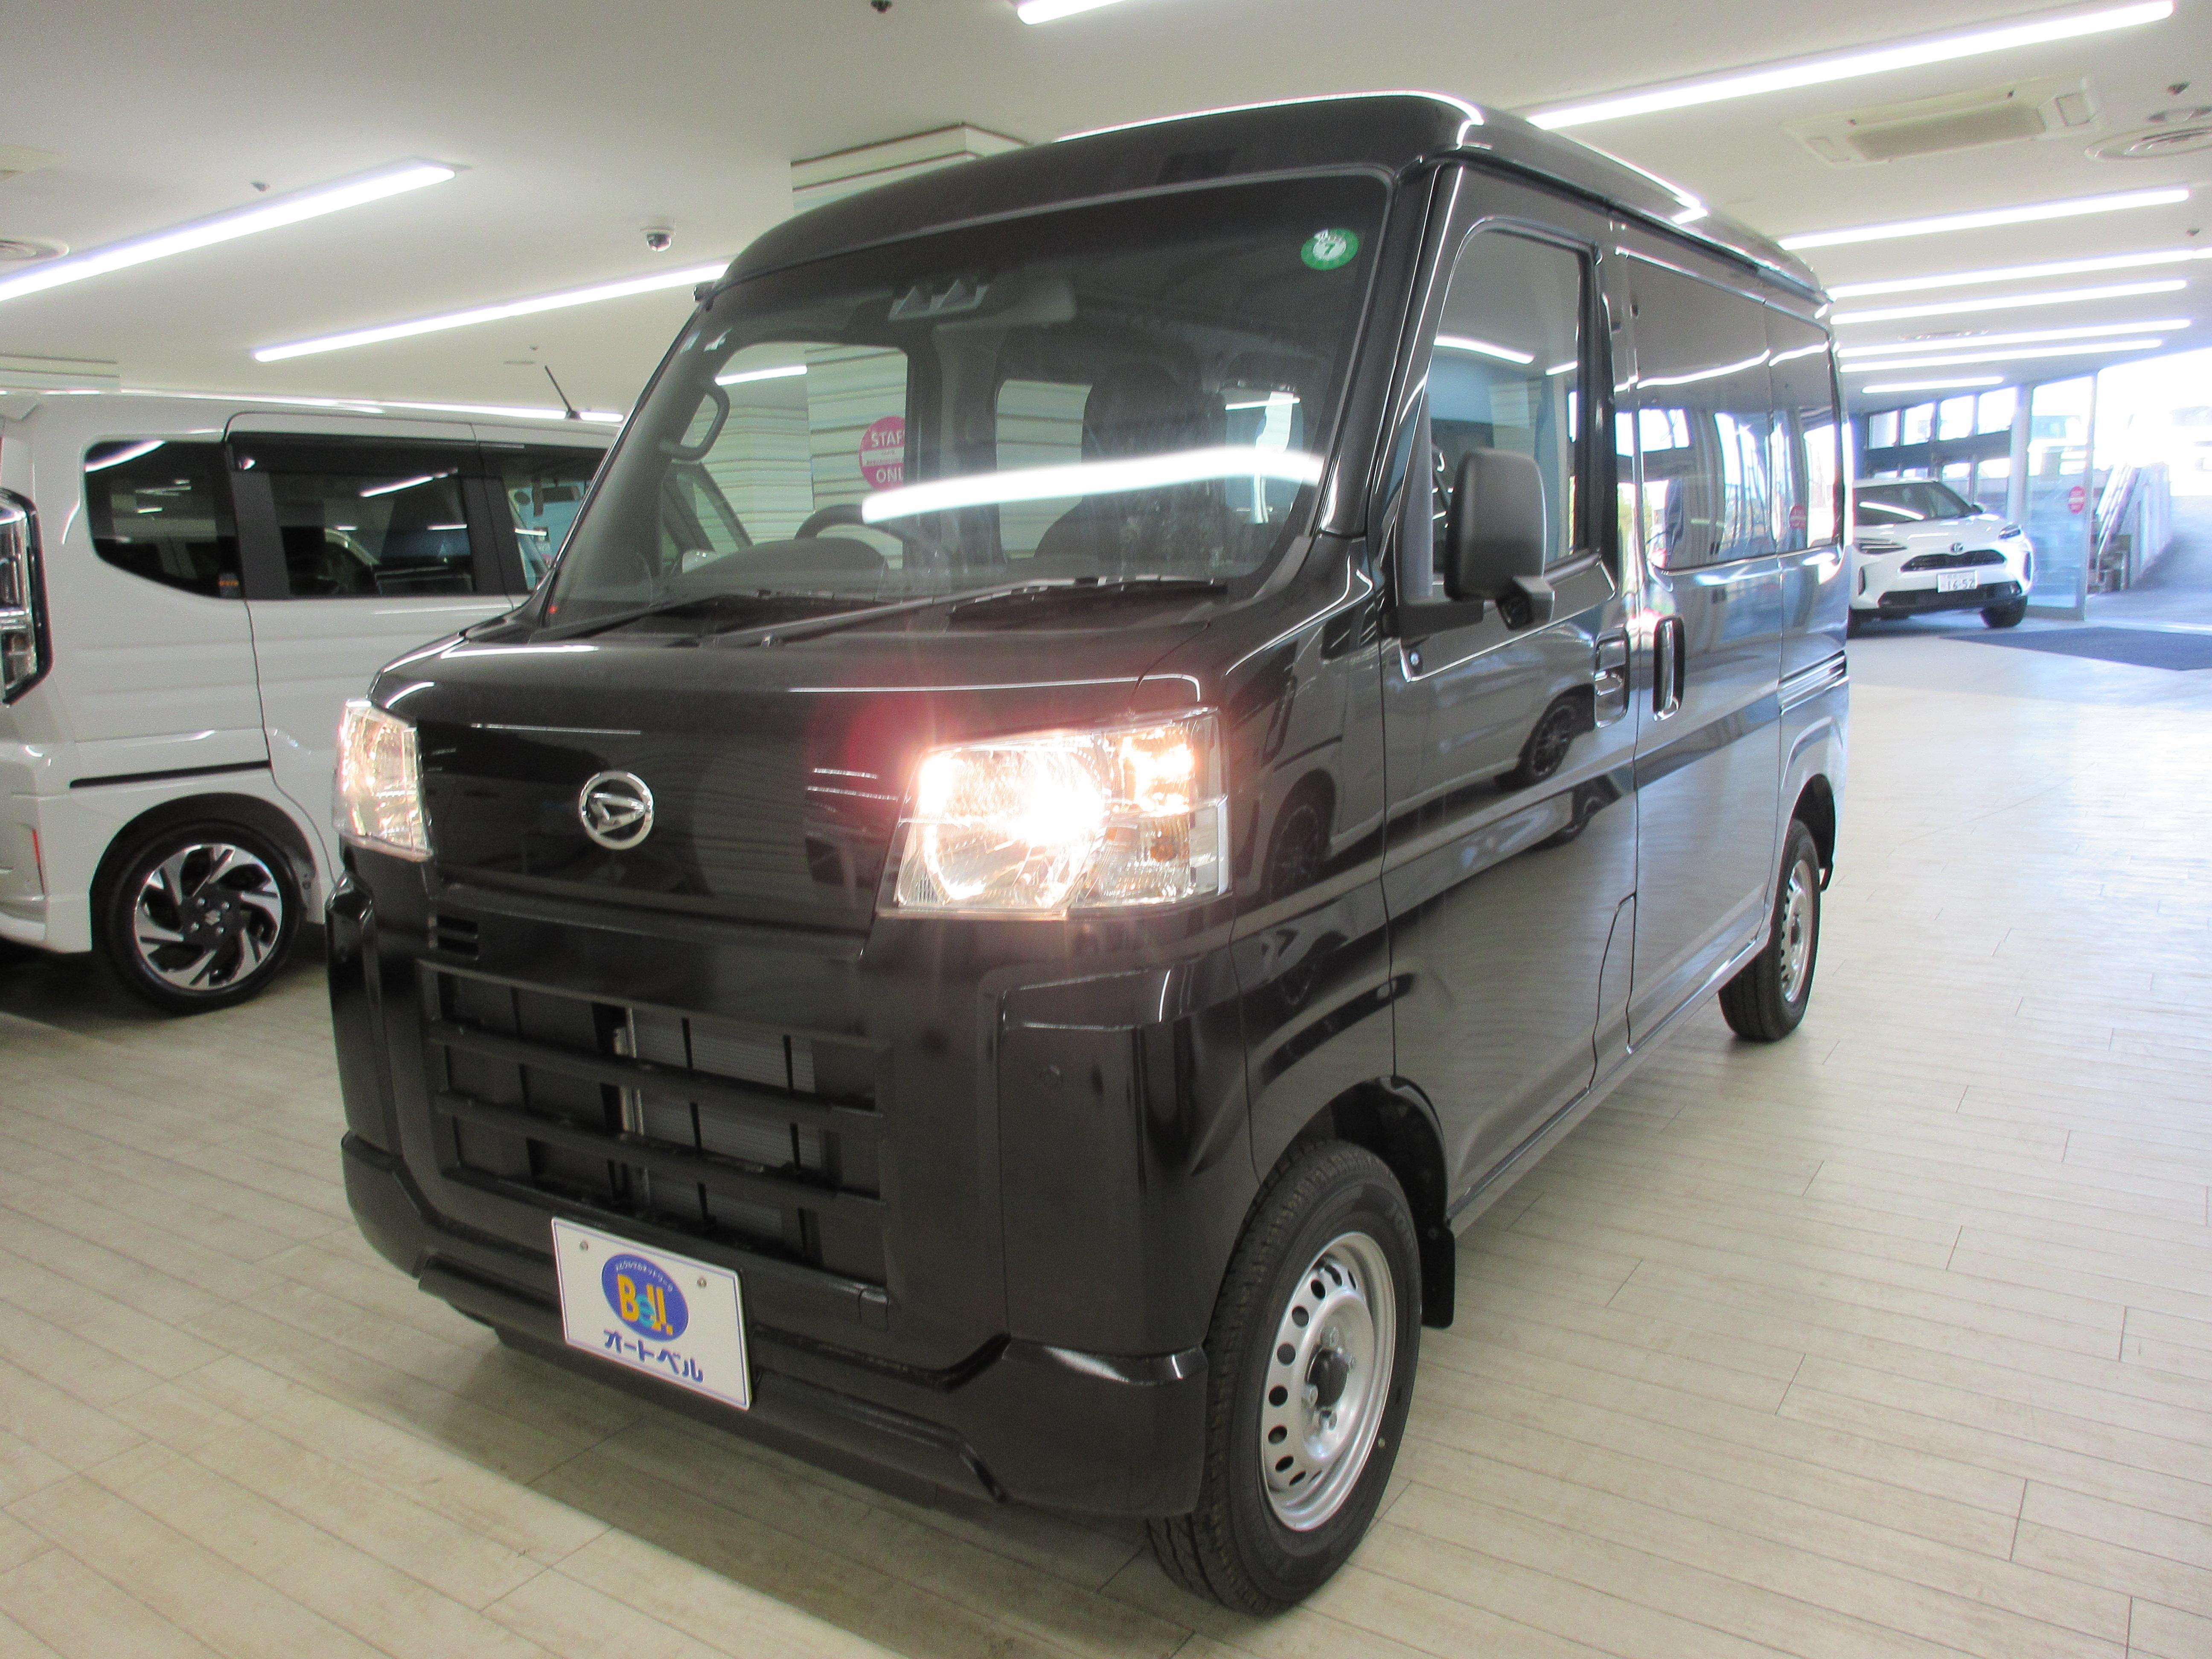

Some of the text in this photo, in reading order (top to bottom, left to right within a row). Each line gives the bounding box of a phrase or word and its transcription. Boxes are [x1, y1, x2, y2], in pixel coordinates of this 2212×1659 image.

[1323, 242, 1336, 256] 7
[871, 430, 905, 447] STAF
[603, 1328, 704, 1382] オートベル
